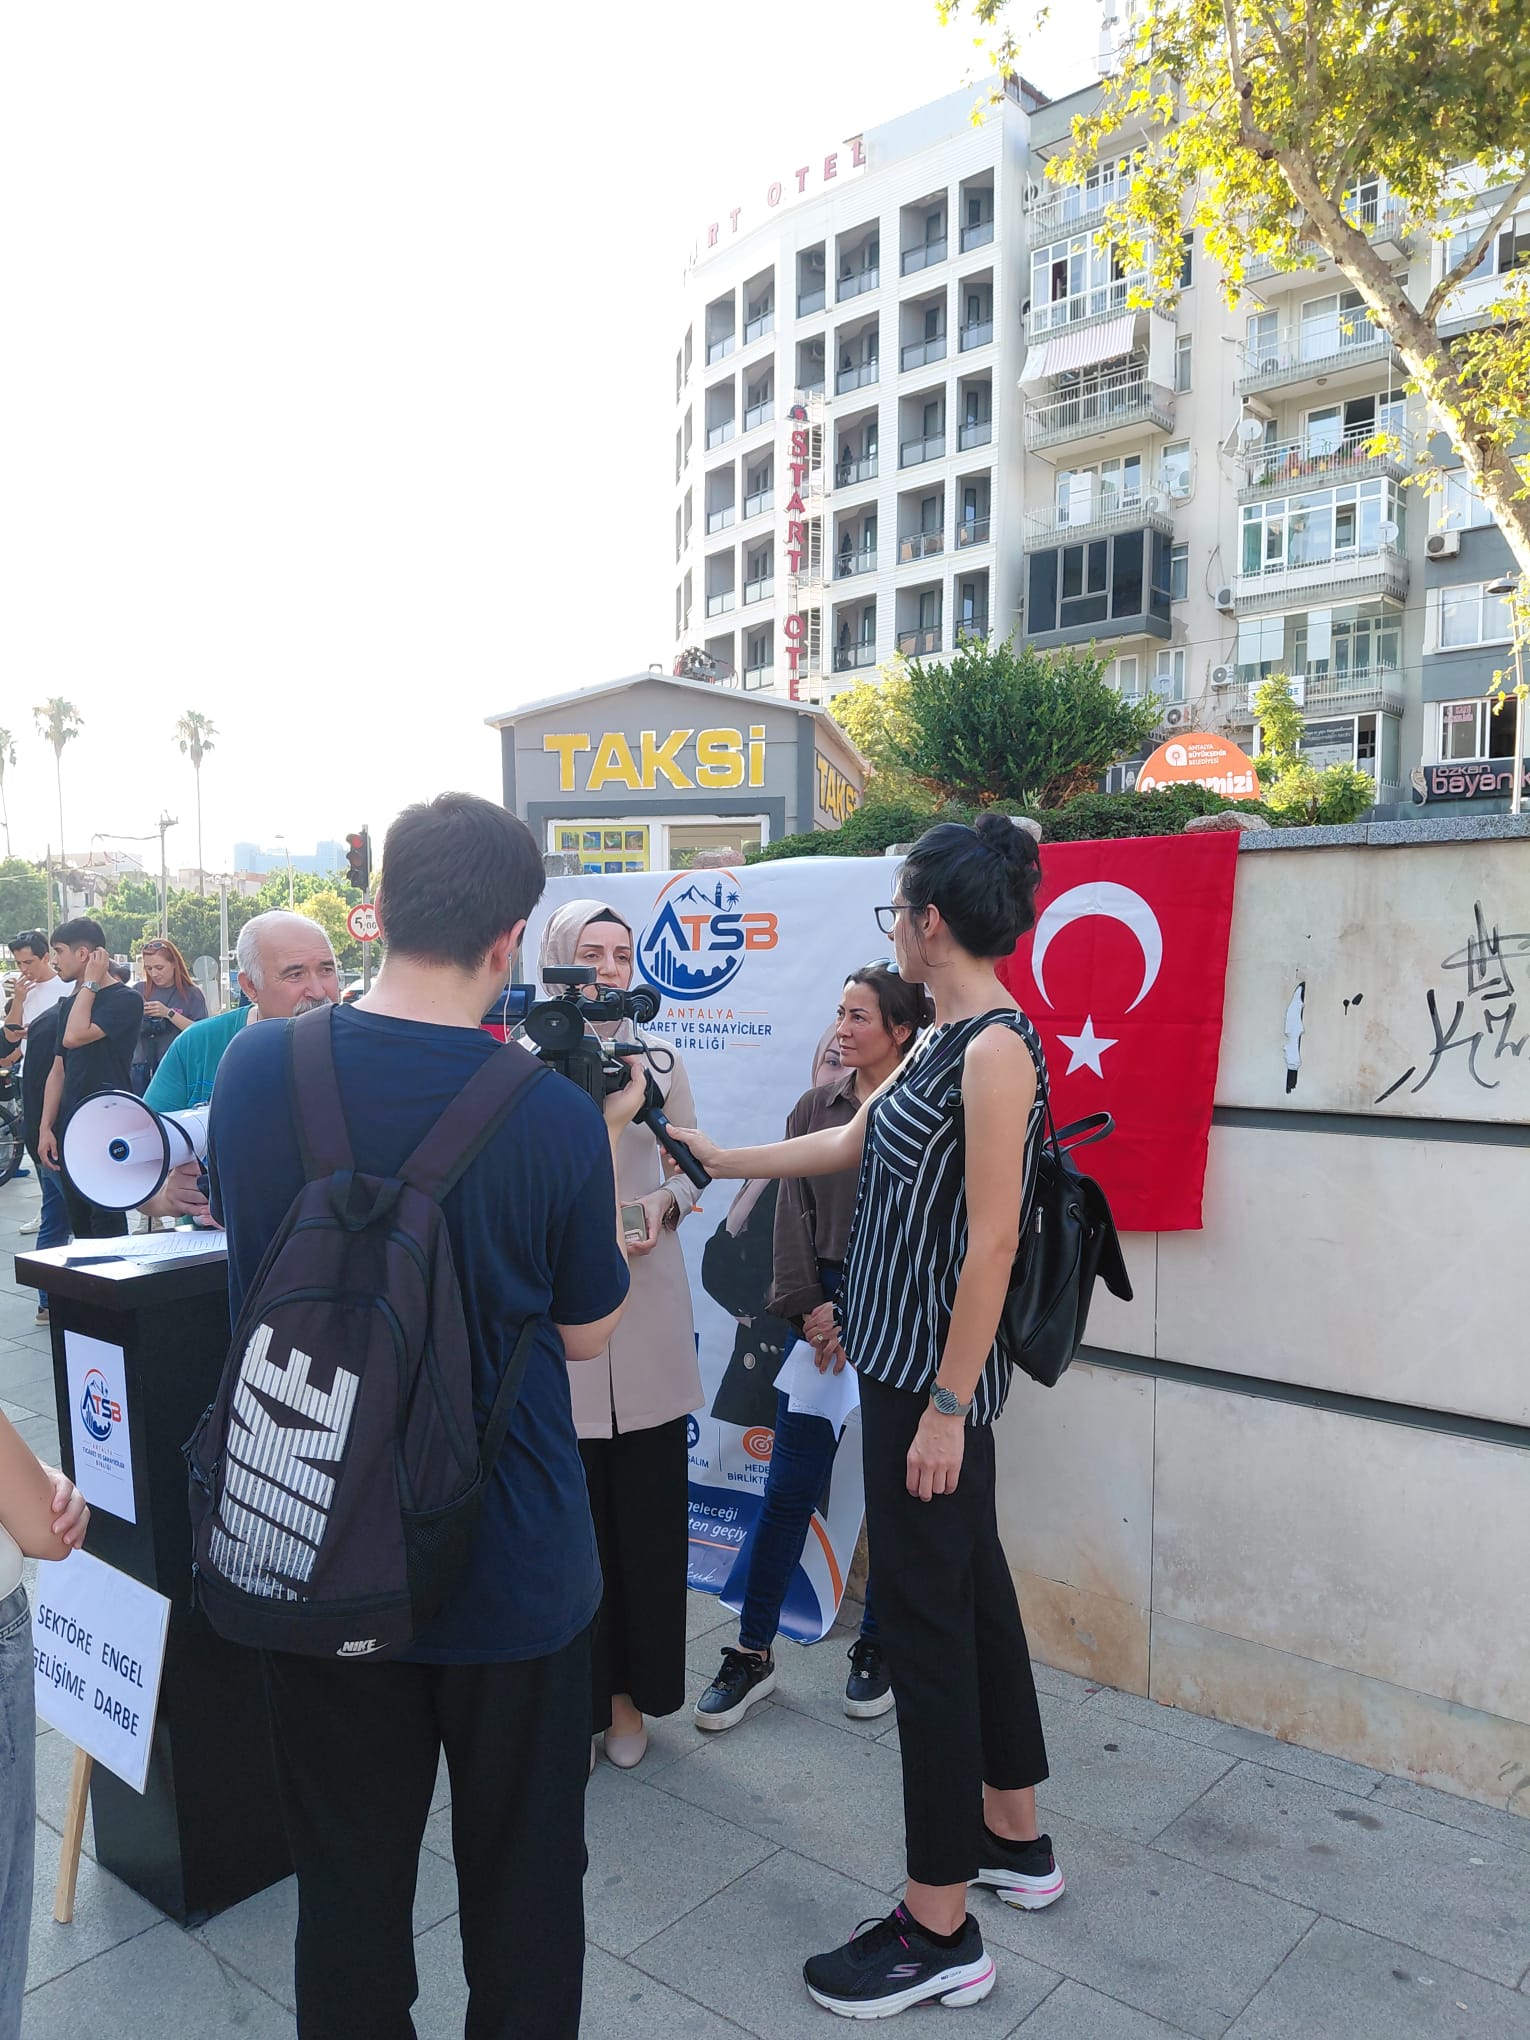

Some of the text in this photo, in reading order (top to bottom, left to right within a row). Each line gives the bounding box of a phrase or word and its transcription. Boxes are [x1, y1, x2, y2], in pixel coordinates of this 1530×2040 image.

[784, 430, 808, 574] START
[1432, 768, 1514, 797] bayan
[643, 900, 779, 952] ATSB
[639, 1021, 772, 1036] CARET VE SANAYİCİLER
[667, 1007, 734, 1020] ANTALYA
[675, 1036, 725, 1050] BİRLİĞİ
[82, 1384, 122, 1422] ATSB
[38, 1604, 143, 1689] SEKTÖRE ENGEL
[342, 1639, 377, 1651] NIKE
[94, 1687, 139, 1737] DARBE
